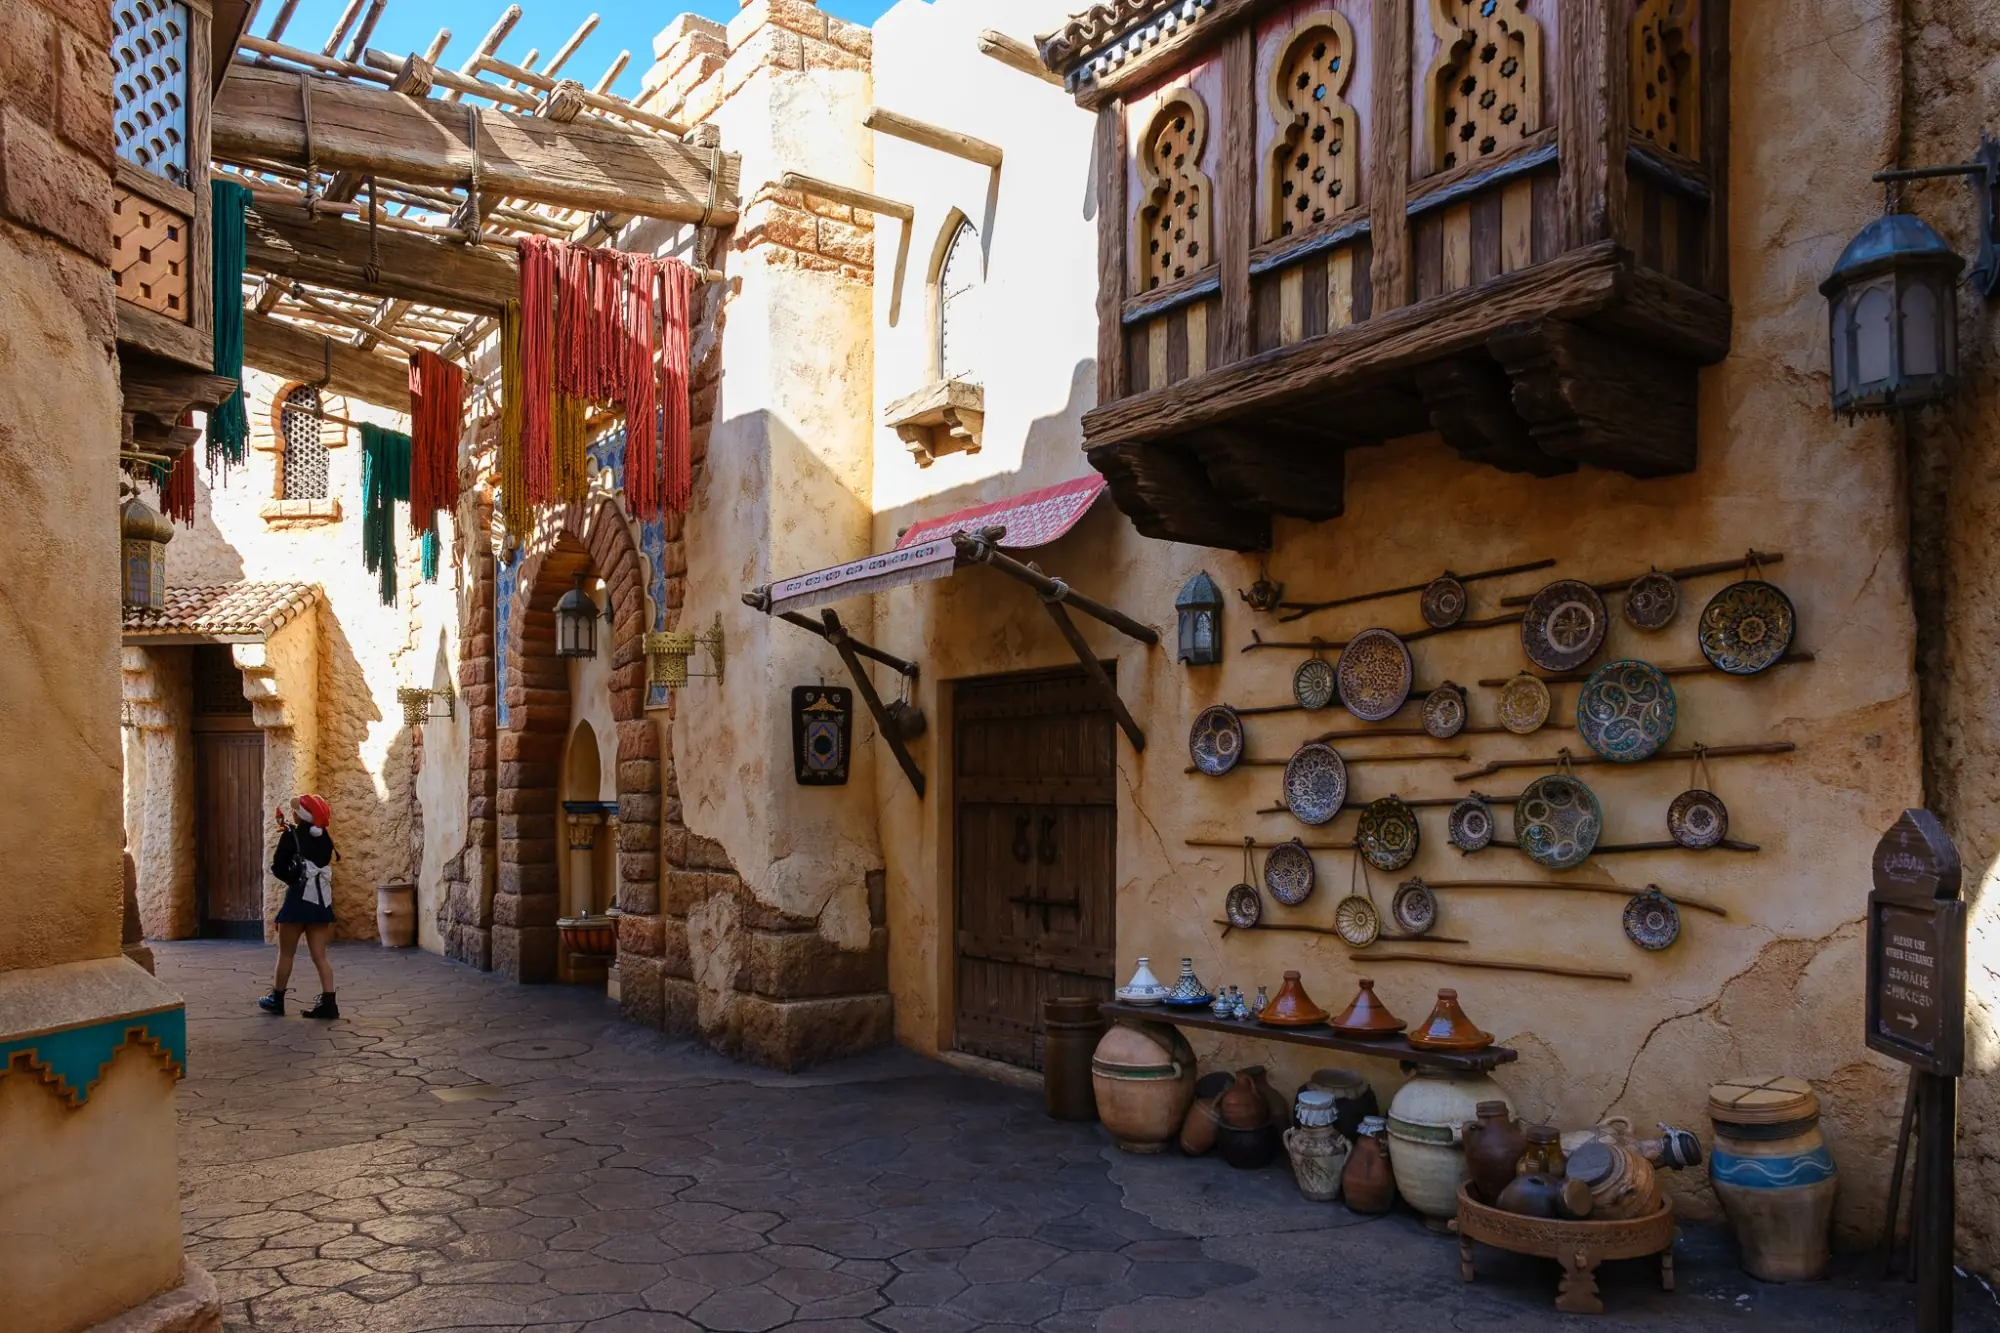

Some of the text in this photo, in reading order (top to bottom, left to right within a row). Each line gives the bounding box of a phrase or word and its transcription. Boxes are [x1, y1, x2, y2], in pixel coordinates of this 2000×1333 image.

[1893, 934, 1926, 951] PLEASE USE
[1885, 946, 1934, 968] OTHER ENTRANCE
